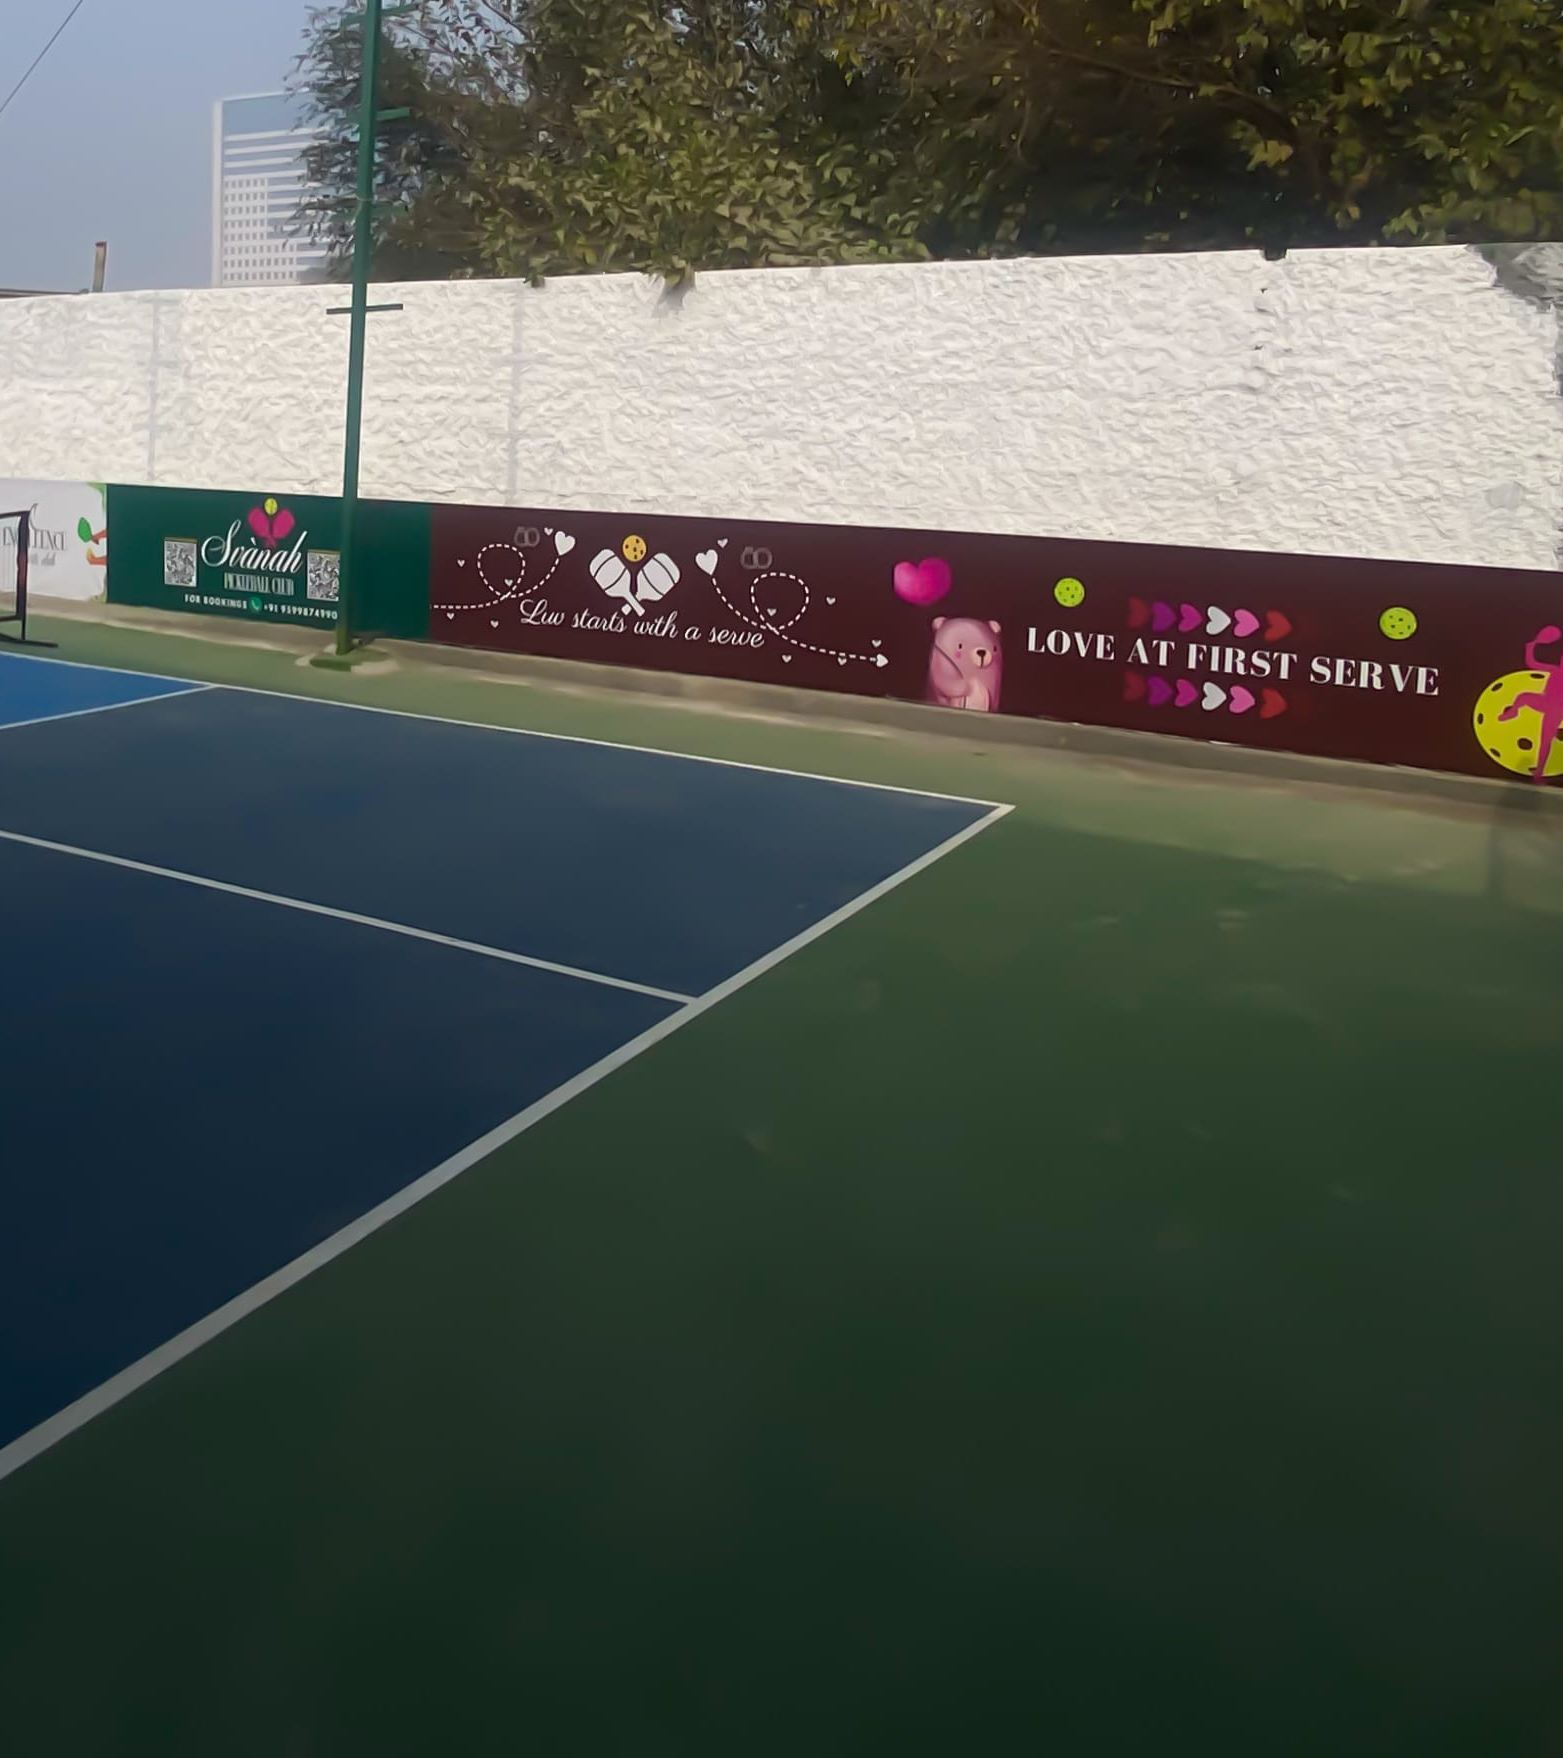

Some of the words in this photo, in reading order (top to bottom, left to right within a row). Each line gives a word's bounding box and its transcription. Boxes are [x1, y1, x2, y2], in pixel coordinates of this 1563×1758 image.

[184, 594, 201, 604] FOR
[203, 595, 248, 610] BOOKINGS
[519, 598, 565, 626] Luv
[571, 607, 628, 634] starts
[633, 610, 679, 639] with
[684, 625, 702, 641] a
[708, 626, 765, 649] serve
[1025, 626, 1116, 661] LOVE
[1126, 637, 1176, 667] AT
[1186, 642, 1298, 681] FIRST
[1308, 655, 1439, 697] SERVE
